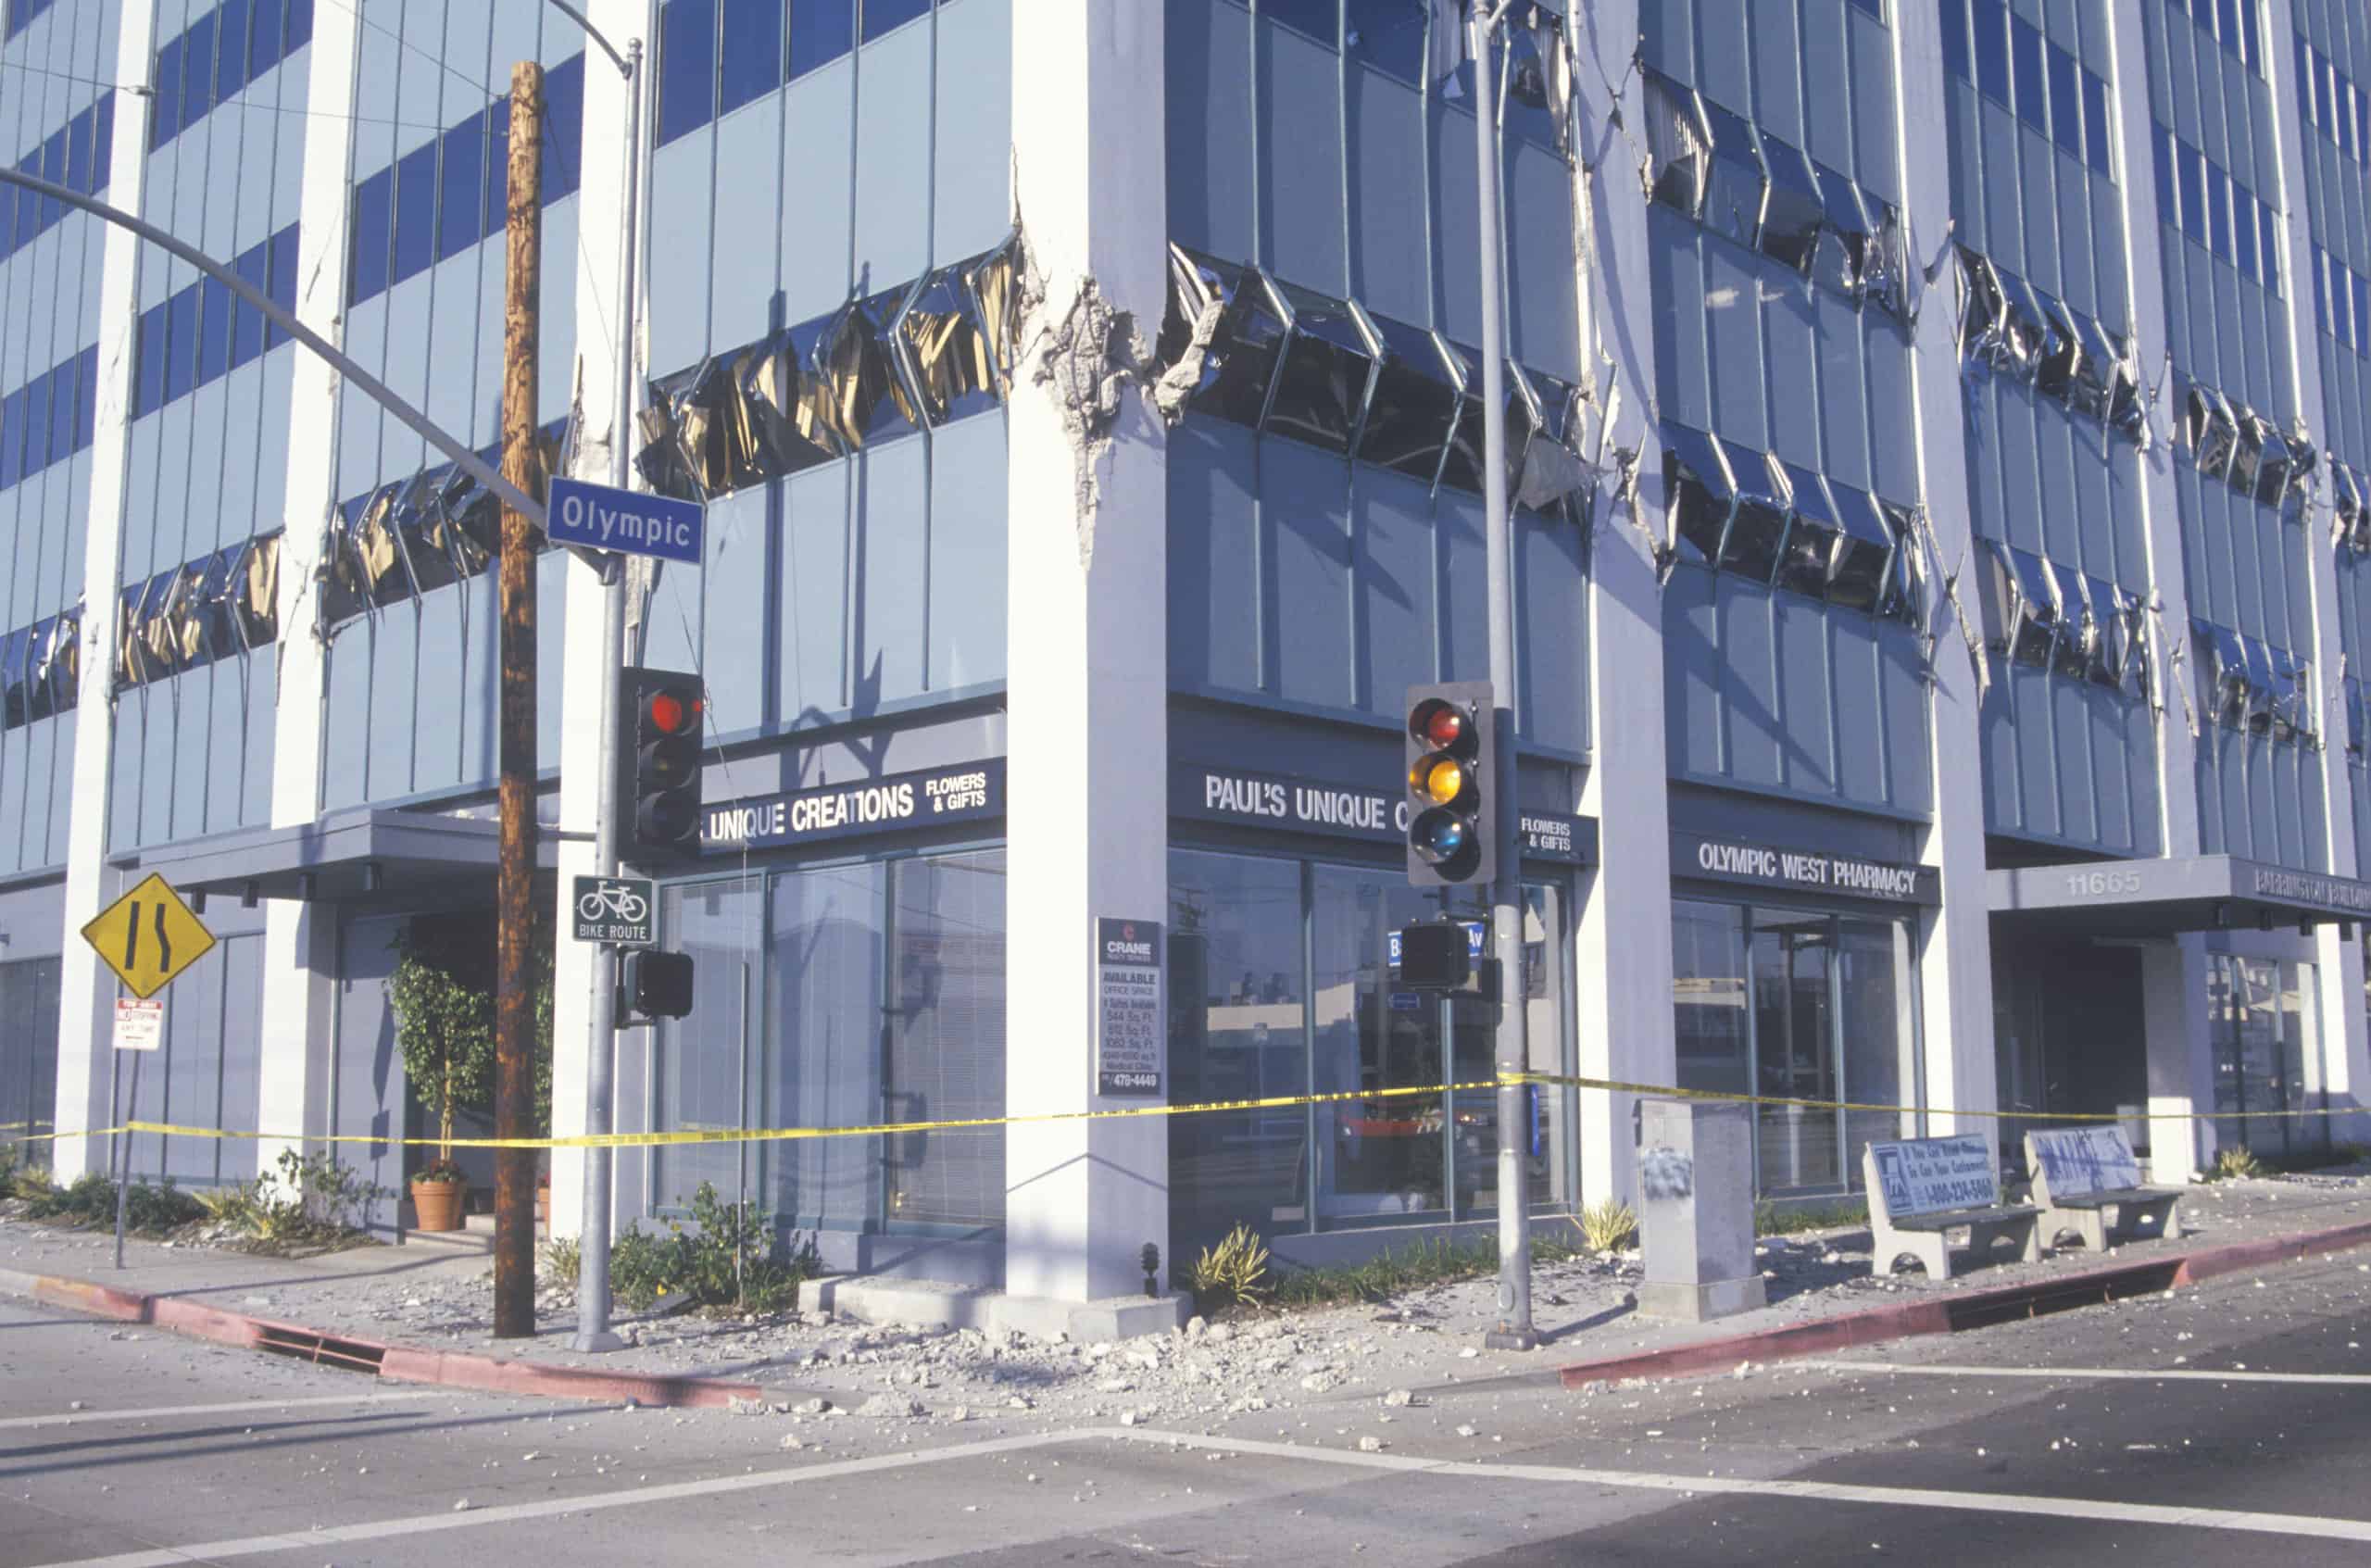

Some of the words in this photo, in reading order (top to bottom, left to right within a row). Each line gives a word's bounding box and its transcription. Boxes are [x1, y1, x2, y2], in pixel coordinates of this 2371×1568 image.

[562, 495, 690, 547] Olympic
[926, 771, 985, 797] FLOWERS
[710, 802, 784, 840] UNIQUE
[792, 784, 914, 832] CREATIONS
[934, 797, 943, 812] &
[947, 790, 985, 810] GIFTS
[1206, 774, 1286, 817] PAUL'S
[1297, 787, 1386, 829] UNIQUE
[1522, 817, 1571, 836] FLOWERS
[1529, 834, 1537, 847] &
[1540, 834, 1571, 851] GIFTS
[1699, 842, 1776, 878] OLYMPIC
[1781, 853, 1828, 884] WEST
[1833, 859, 1915, 894] PHARMACY
[2066, 872, 2141, 897] 11665
[580, 923, 605, 938] BIKE
[609, 924, 646, 939] ROUTE
[1107, 940, 1151, 955] CRANE
[1104, 970, 1157, 985] AVAILABLE
